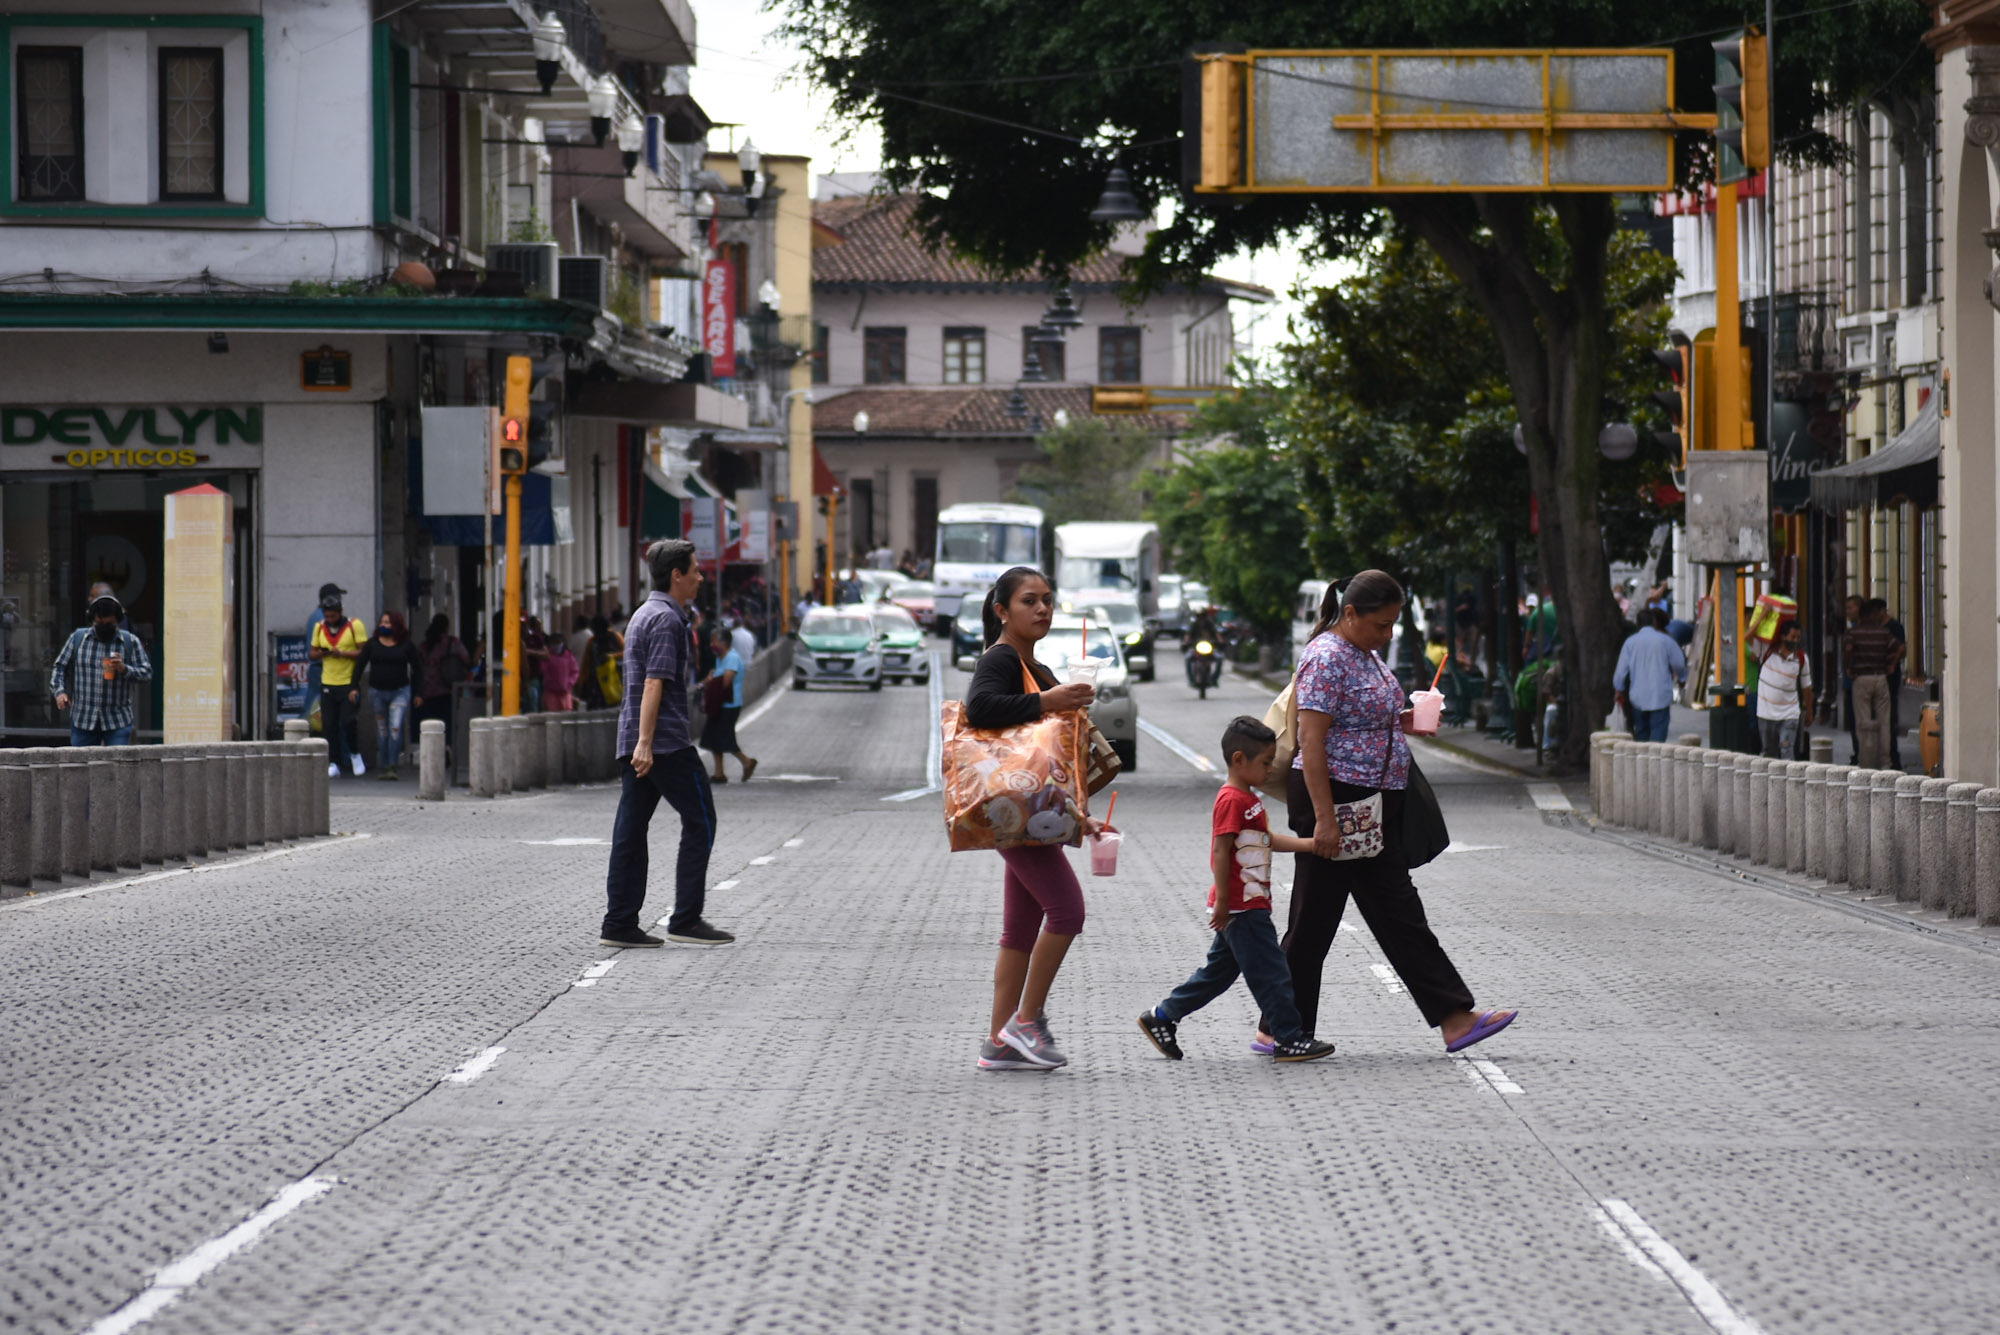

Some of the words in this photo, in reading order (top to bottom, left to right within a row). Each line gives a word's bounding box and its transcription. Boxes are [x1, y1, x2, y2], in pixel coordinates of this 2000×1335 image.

[707, 266, 727, 357] SEARS
[2, 407, 262, 445] DEVLYN
[66, 449, 197, 467] OPTICOS
